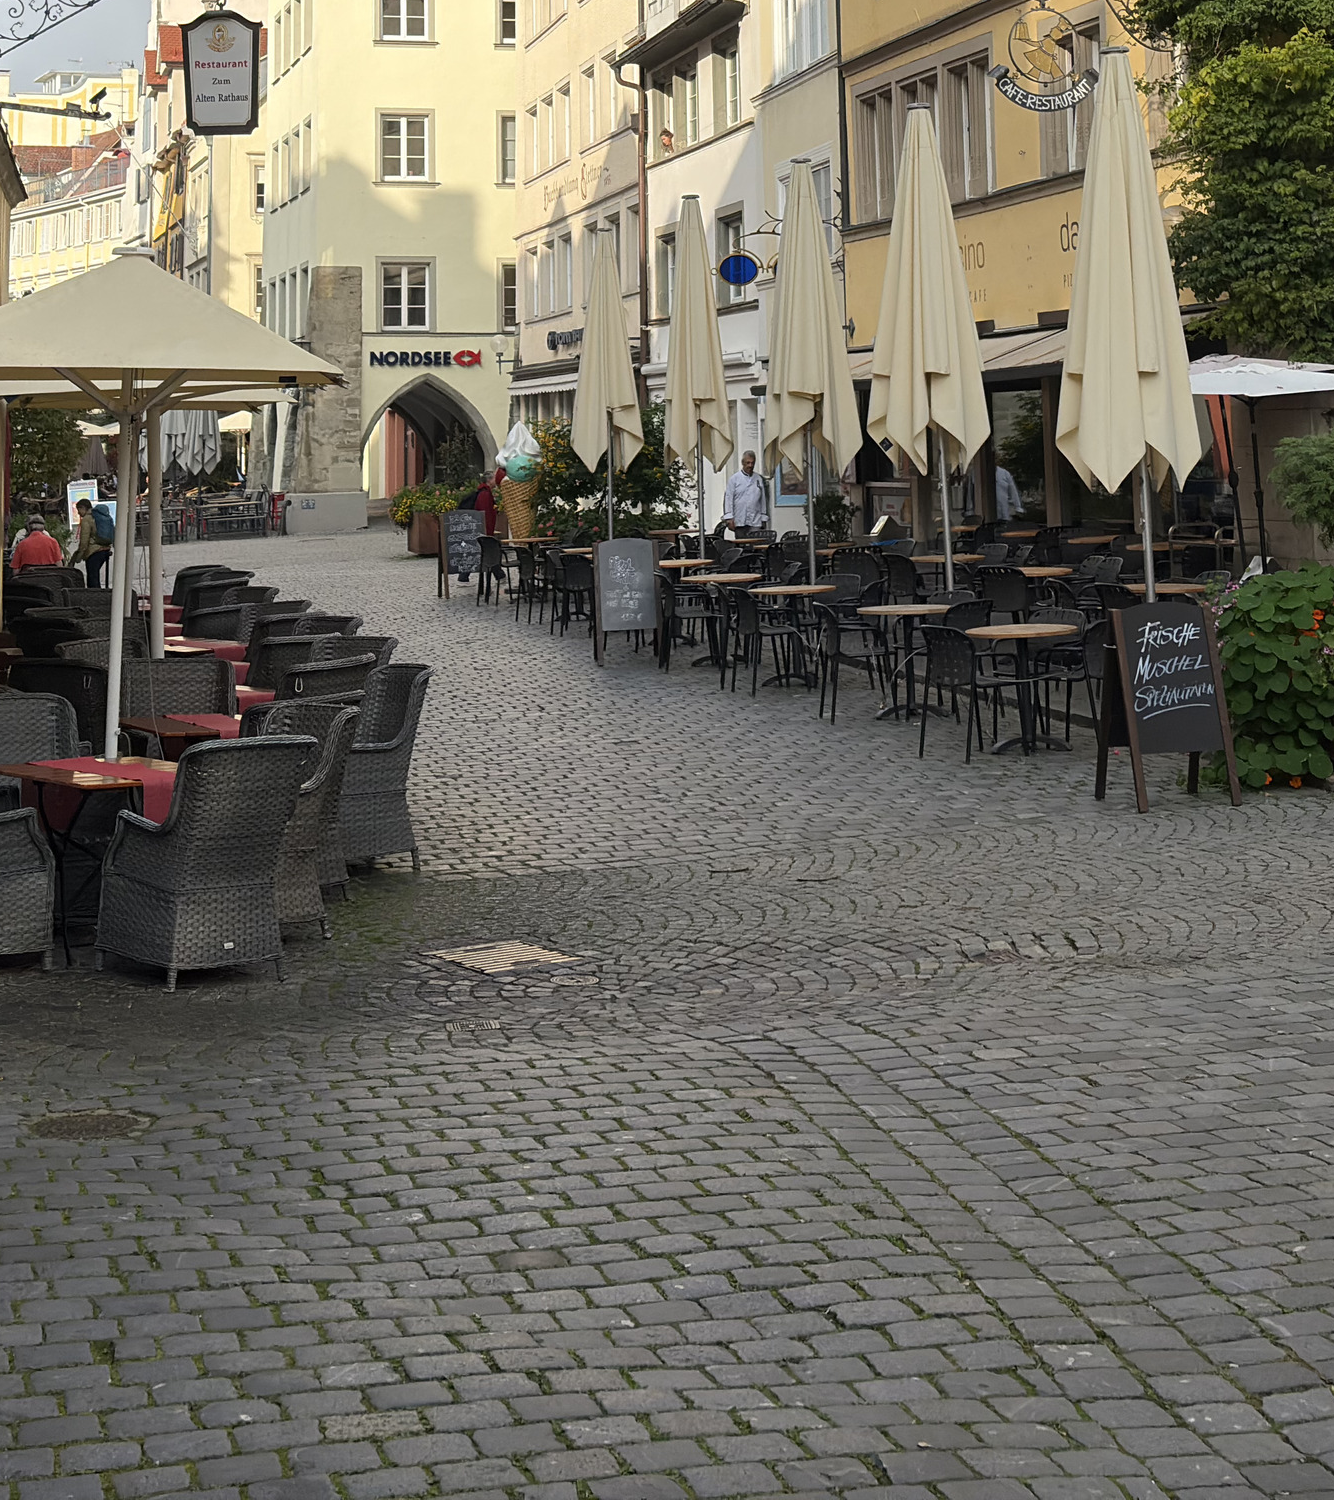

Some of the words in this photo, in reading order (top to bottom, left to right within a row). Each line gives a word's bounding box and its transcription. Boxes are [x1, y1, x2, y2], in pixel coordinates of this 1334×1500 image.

[194, 59, 248, 69] Restaurant
[211, 77, 232, 85] Zum
[194, 93, 216, 103] Alten
[218, 92, 249, 102] Rathaus
[998, 77, 1092, 111] CAFE-RESTAURANT
[369, 350, 452, 367] NORDSEE
[1134, 654, 1210, 685] MUSCHEL
